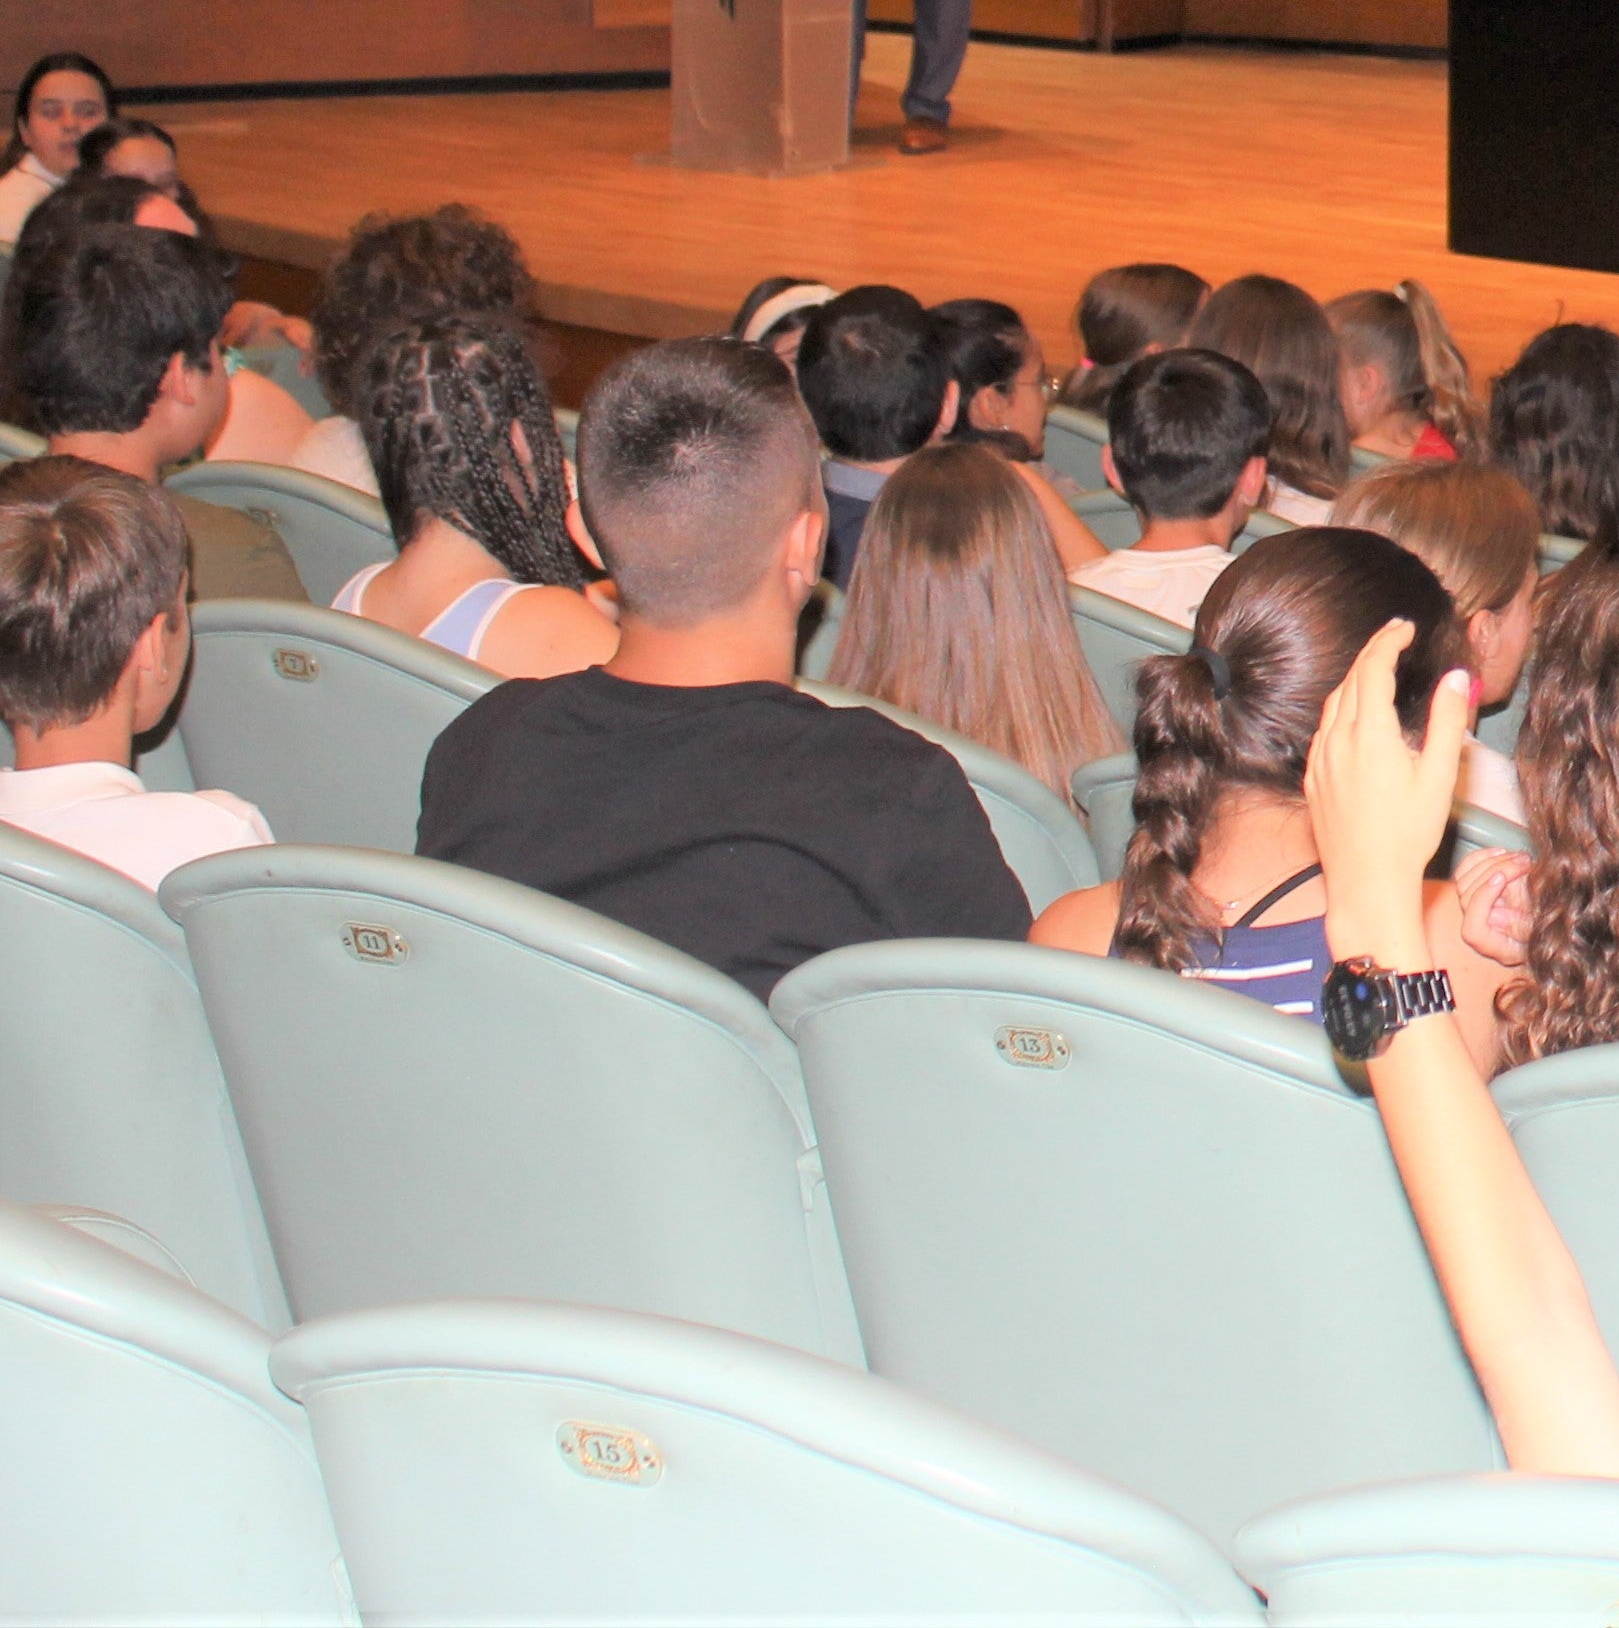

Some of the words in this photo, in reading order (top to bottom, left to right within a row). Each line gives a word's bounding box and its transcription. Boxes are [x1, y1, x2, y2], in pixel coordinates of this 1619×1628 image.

[363, 935, 381, 950] 11
[1020, 1037, 1041, 1054] 13
[594, 1440, 621, 1463] 15
